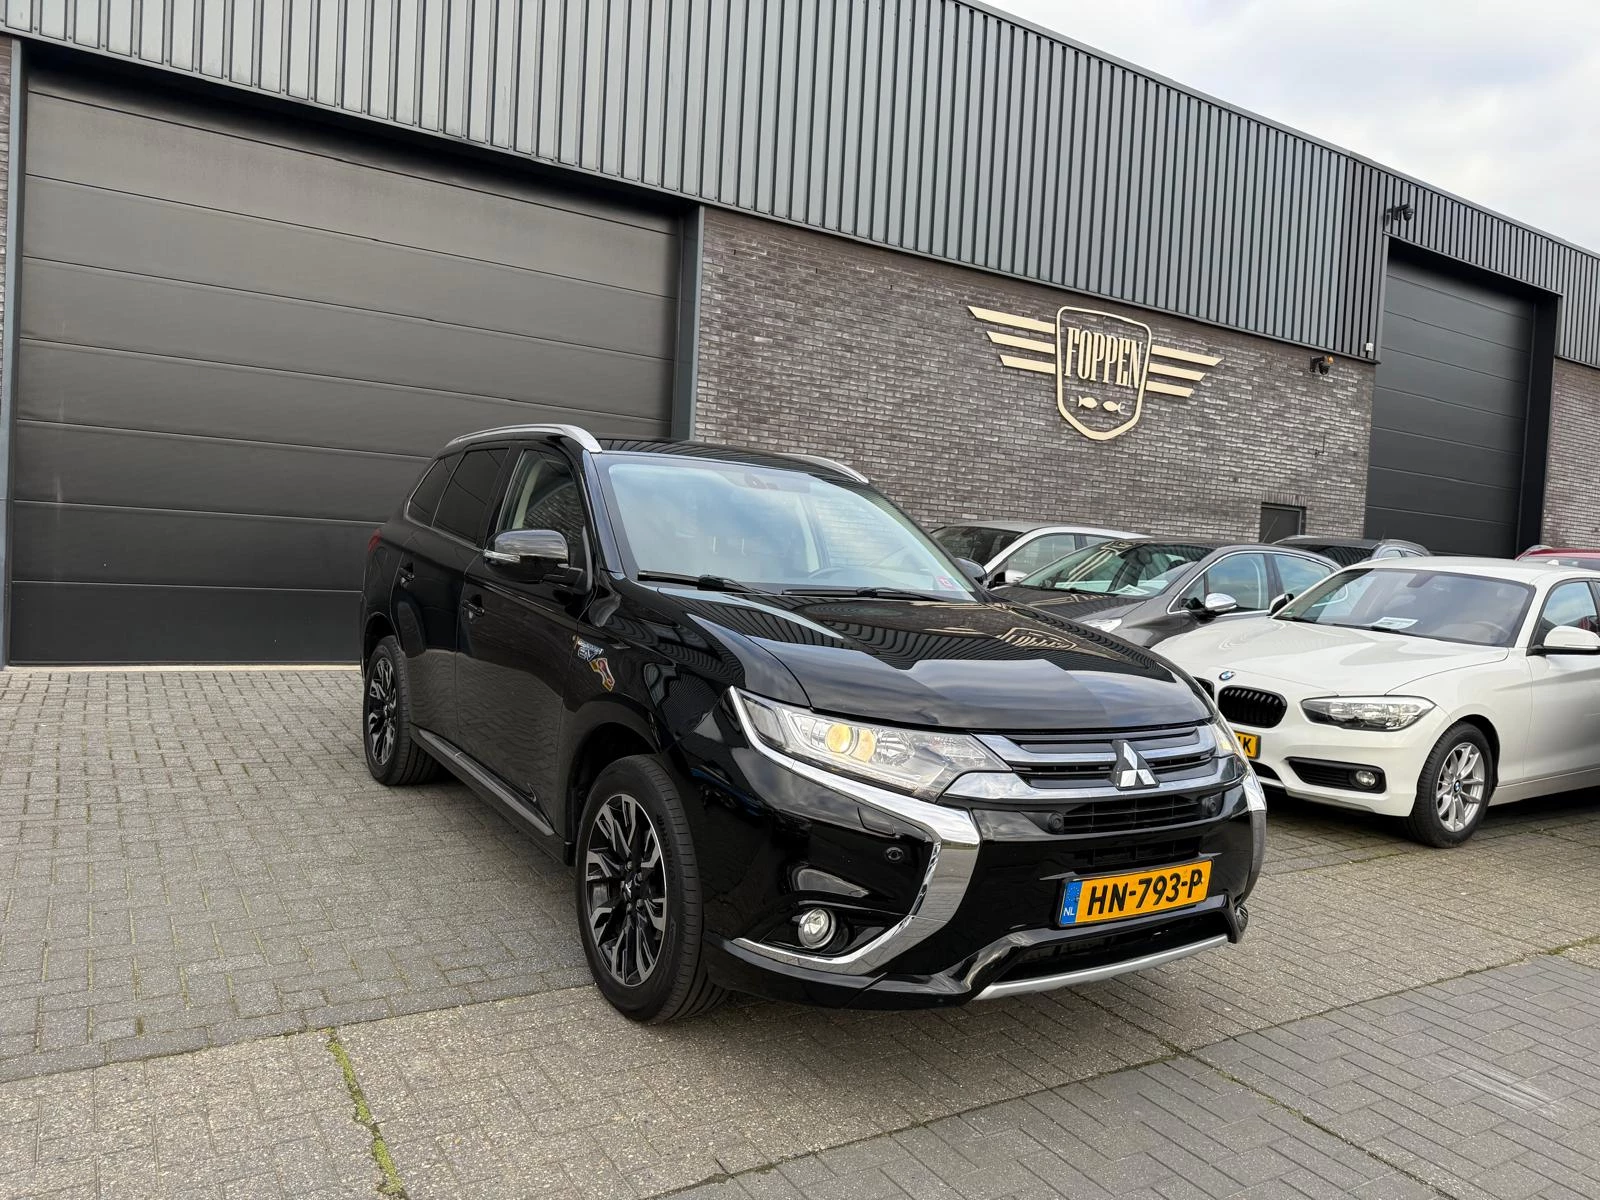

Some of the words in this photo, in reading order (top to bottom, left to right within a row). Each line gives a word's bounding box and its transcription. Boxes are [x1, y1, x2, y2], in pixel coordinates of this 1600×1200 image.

[1064, 326, 1143, 389] FOPPEN
[1063, 906, 1075, 917] NL
[1086, 868, 1203, 916] HN-793-P
